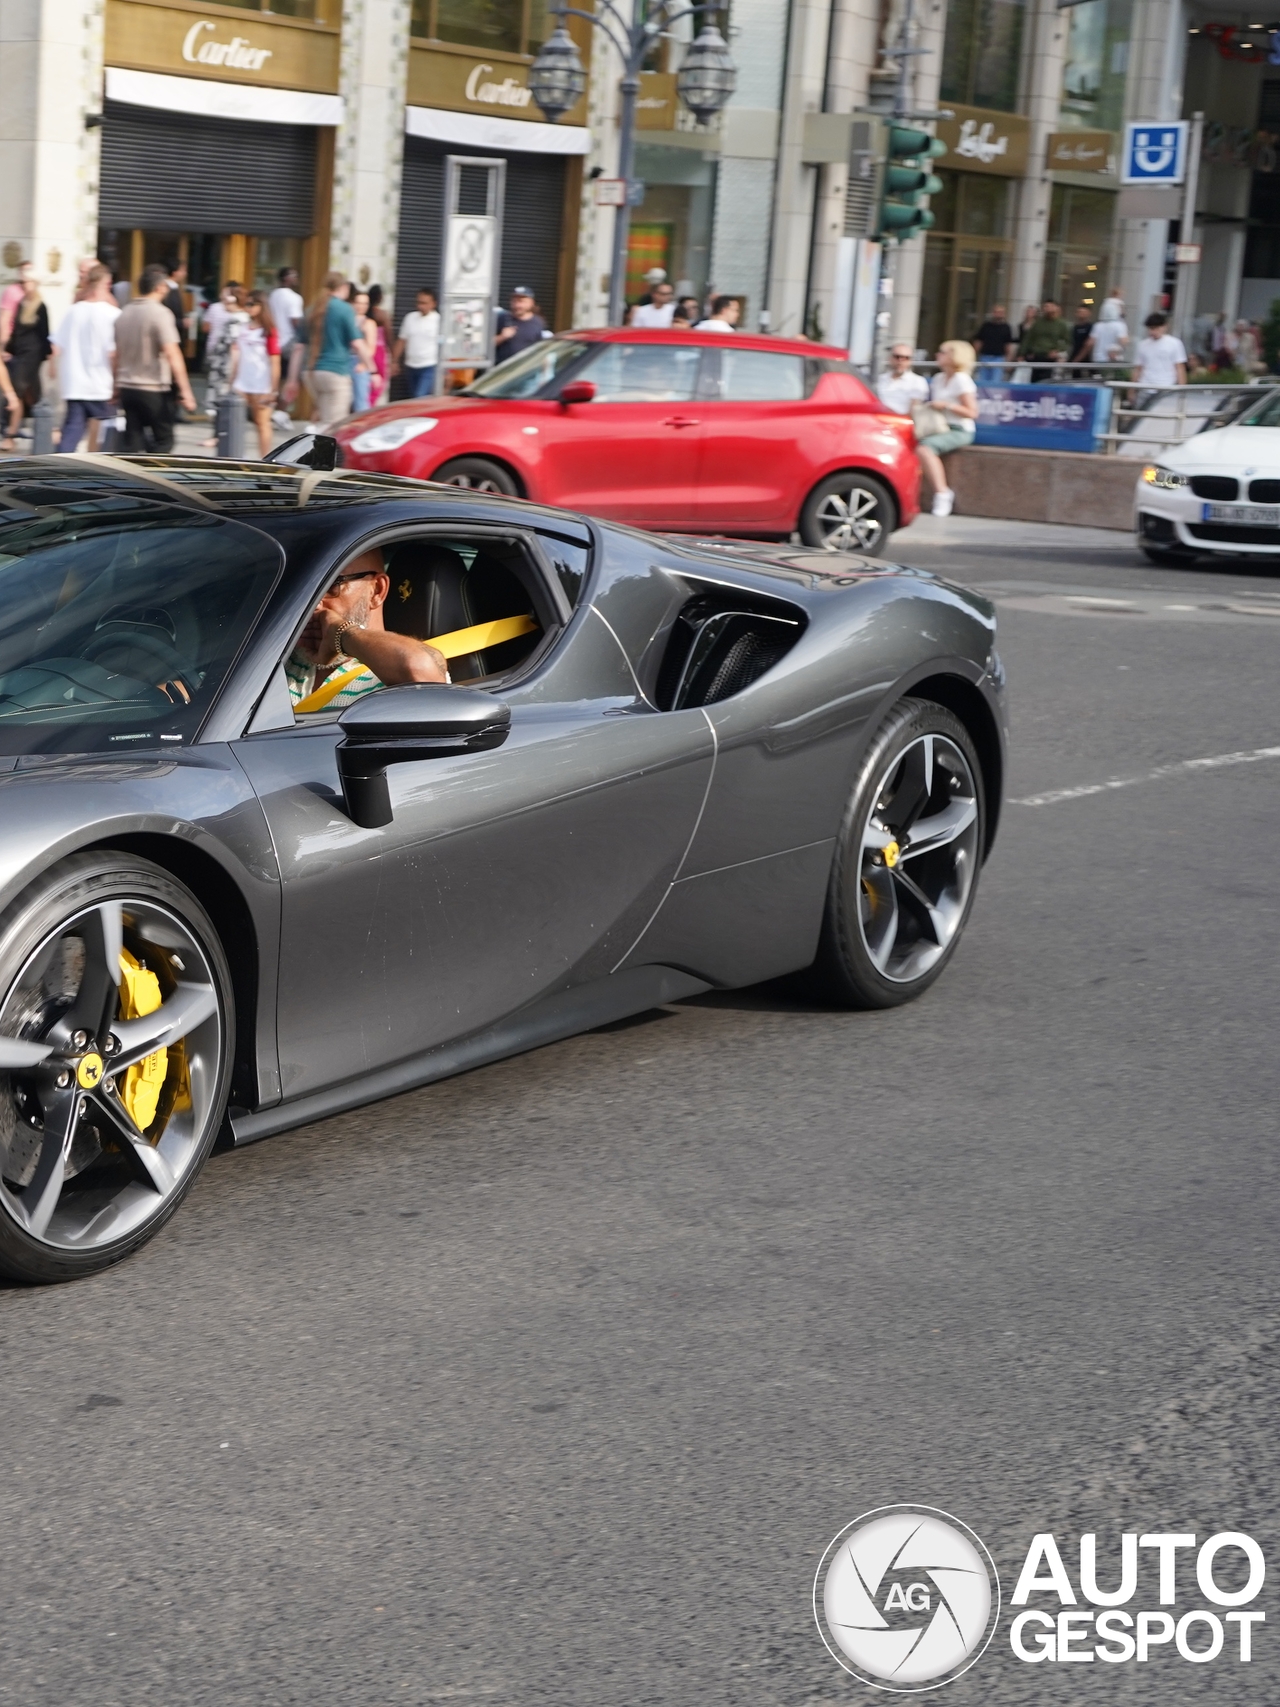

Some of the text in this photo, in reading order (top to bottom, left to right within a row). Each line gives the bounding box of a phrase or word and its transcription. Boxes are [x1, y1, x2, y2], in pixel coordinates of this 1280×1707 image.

[182, 20, 273, 70] Cartier
[465, 63, 533, 107] Cartier
[977, 394, 1085, 422] nigsallee
